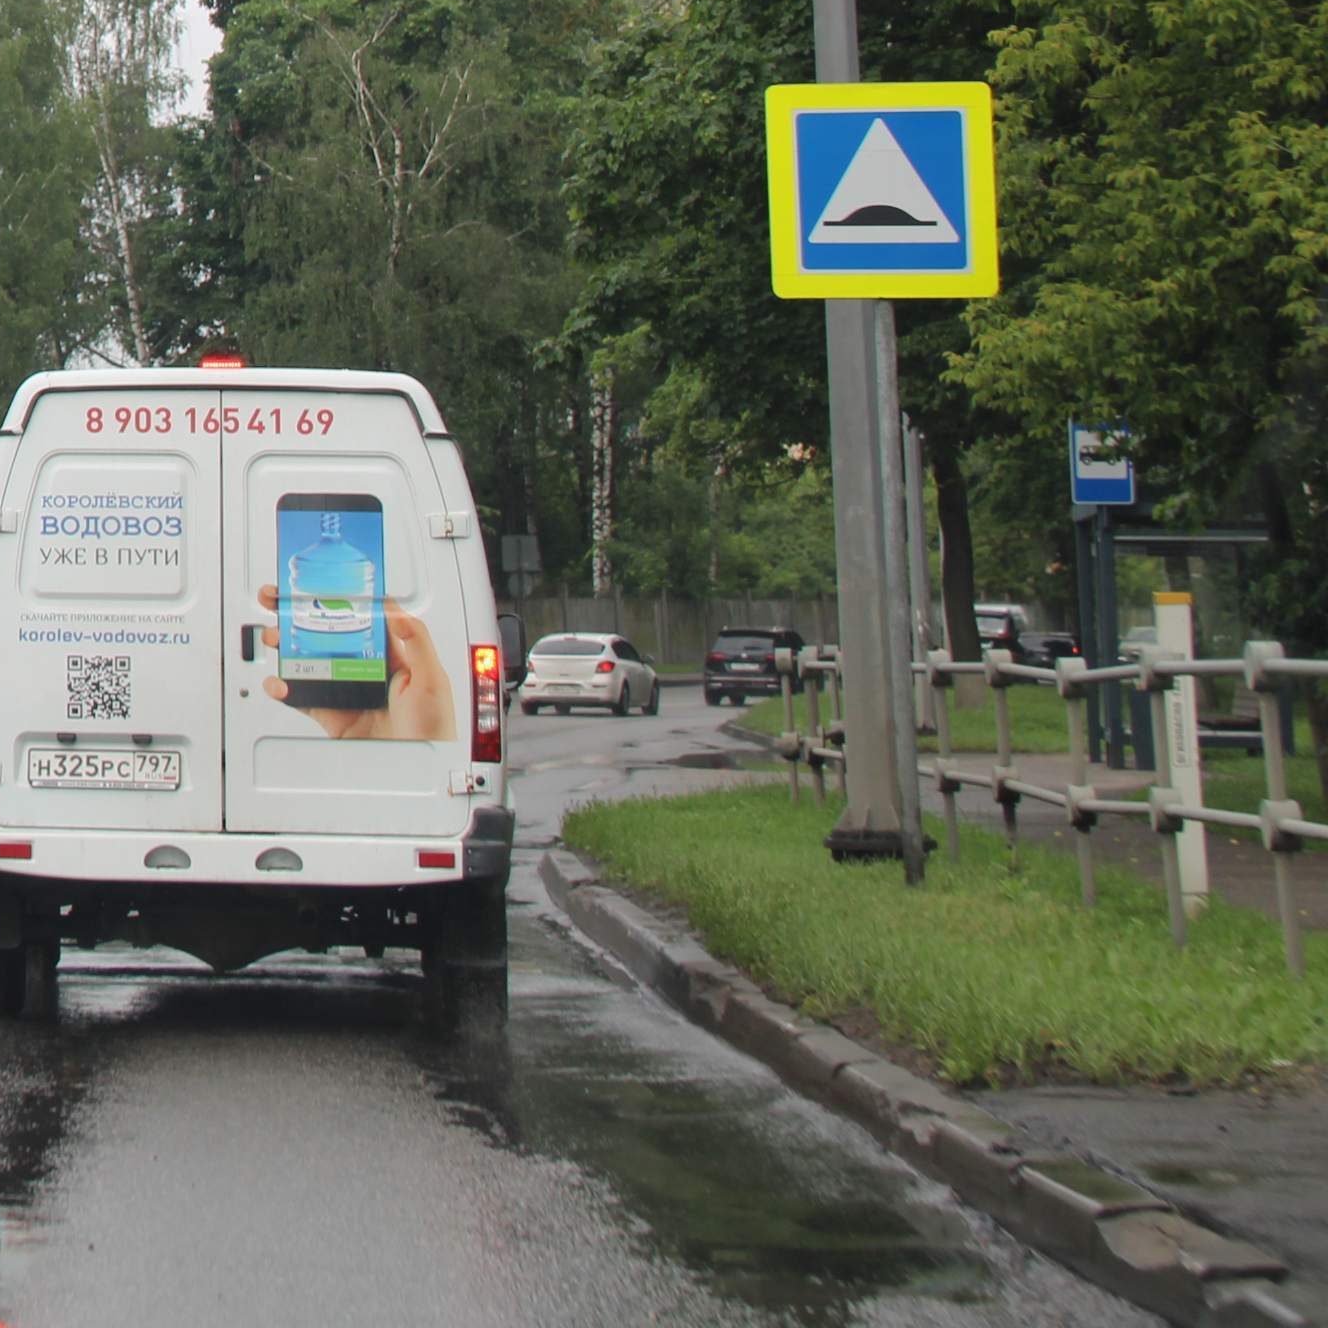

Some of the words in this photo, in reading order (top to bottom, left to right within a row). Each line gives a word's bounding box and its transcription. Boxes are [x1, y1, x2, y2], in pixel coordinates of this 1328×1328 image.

[85, 407, 104, 434] 8
[114, 407, 173, 434] 903
[184, 408, 240, 435] 165
[246, 408, 283, 435] 41
[295, 409, 335, 436] 69
[41, 492, 184, 510] КОРОЛЁВСКИЙ
[40, 516, 183, 539] ВОДОВОЗ
[39, 547, 88, 566] УЖЕ
[94, 548, 109, 565] В
[117, 548, 180, 567] ПУТИ
[20, 612, 69, 623] СКАЧАЙТЕ
[70, 613, 137, 624] ПРИЛОЖЕНИЕ
[138, 614, 152, 624] НА
[154, 613, 186, 625] САЙТЕ
[18, 627, 191, 646] korolev-vodovoz.ru
[37, 754, 132, 779] Н325РС
[136, 755, 173, 773] 797
